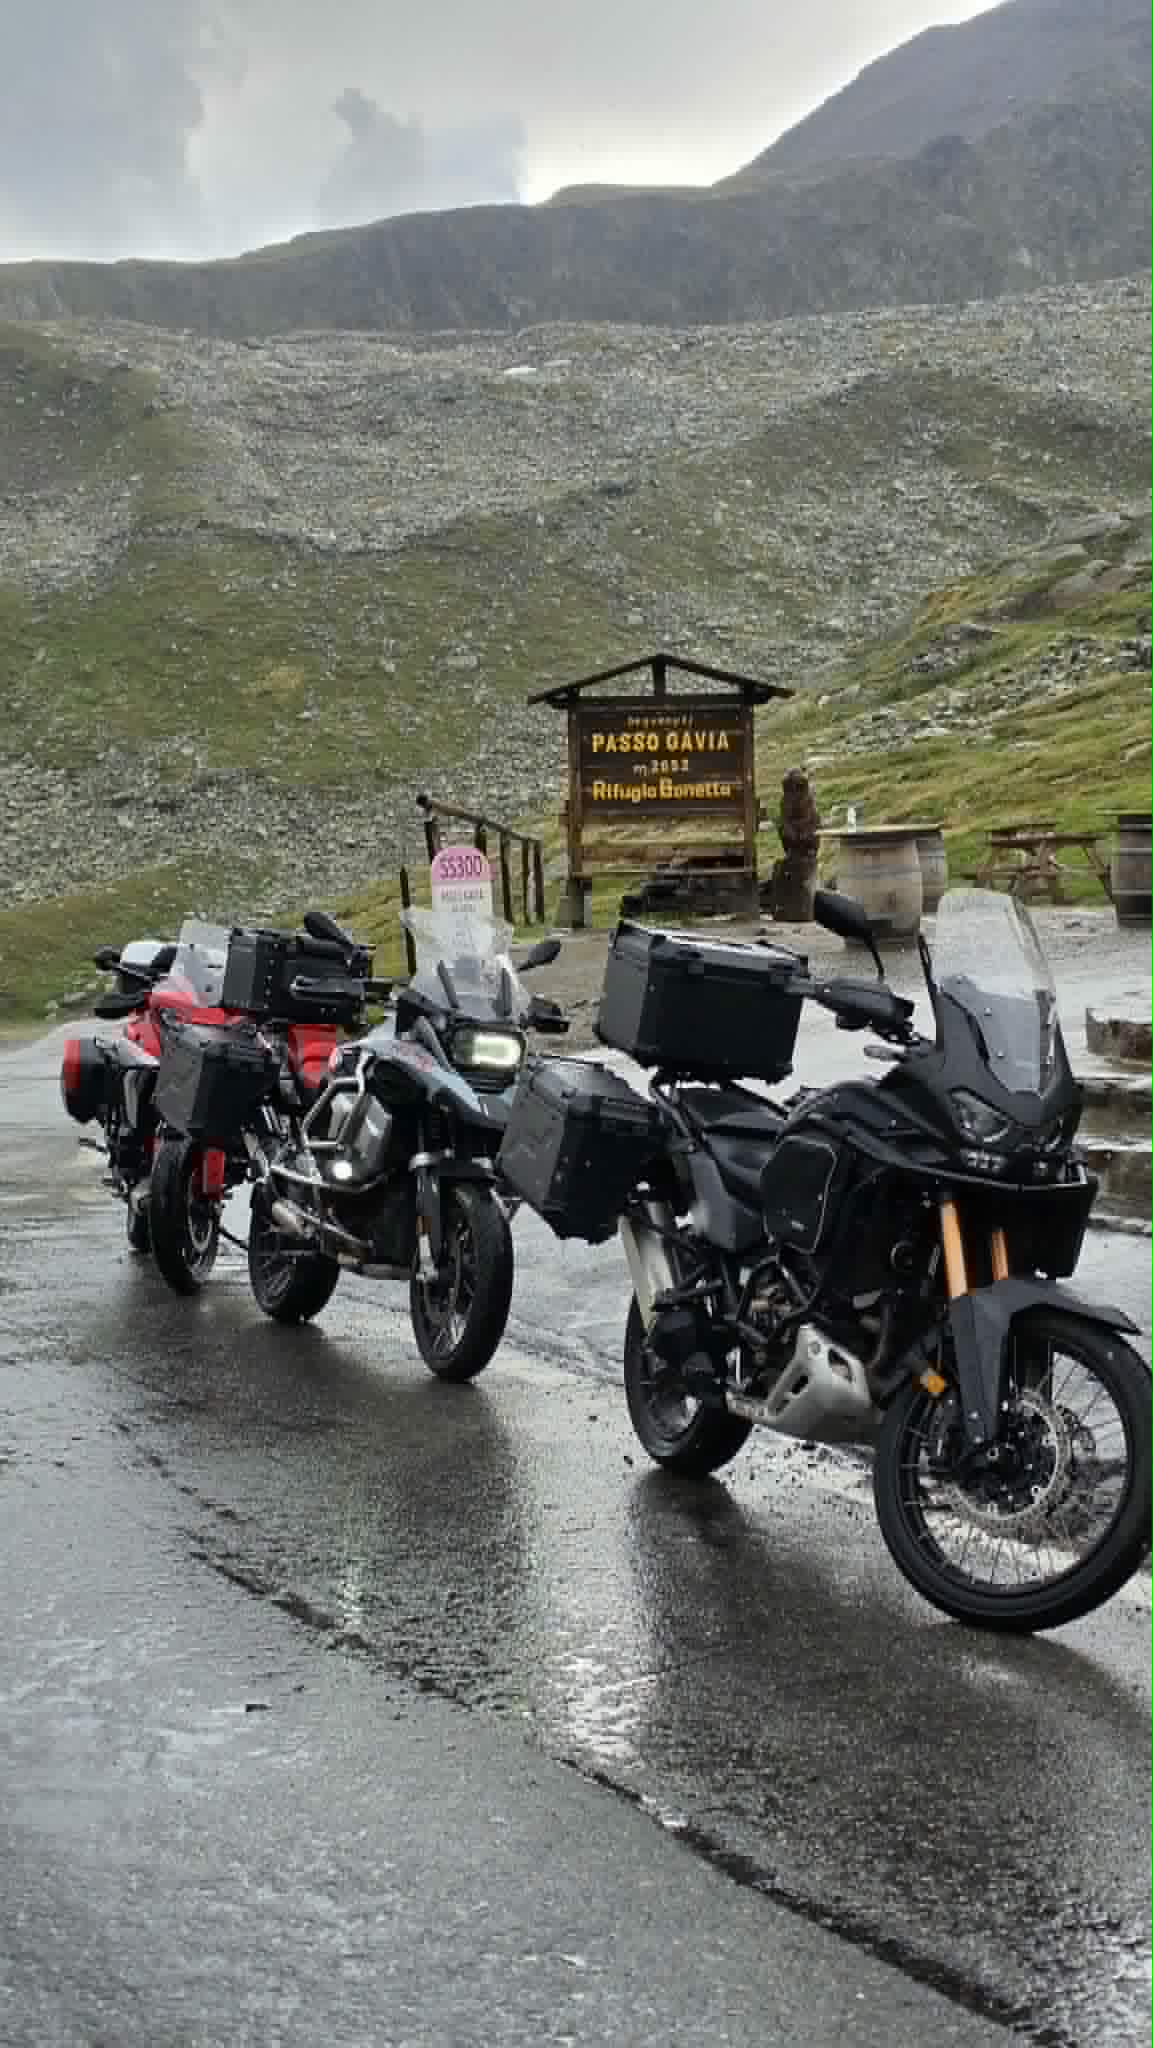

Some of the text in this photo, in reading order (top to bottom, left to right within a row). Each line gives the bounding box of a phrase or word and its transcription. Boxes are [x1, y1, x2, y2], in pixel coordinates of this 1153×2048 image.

[592, 730, 730, 753] PASSO GAVIA
[592, 776, 732, 804] Rifugio Bonetta
